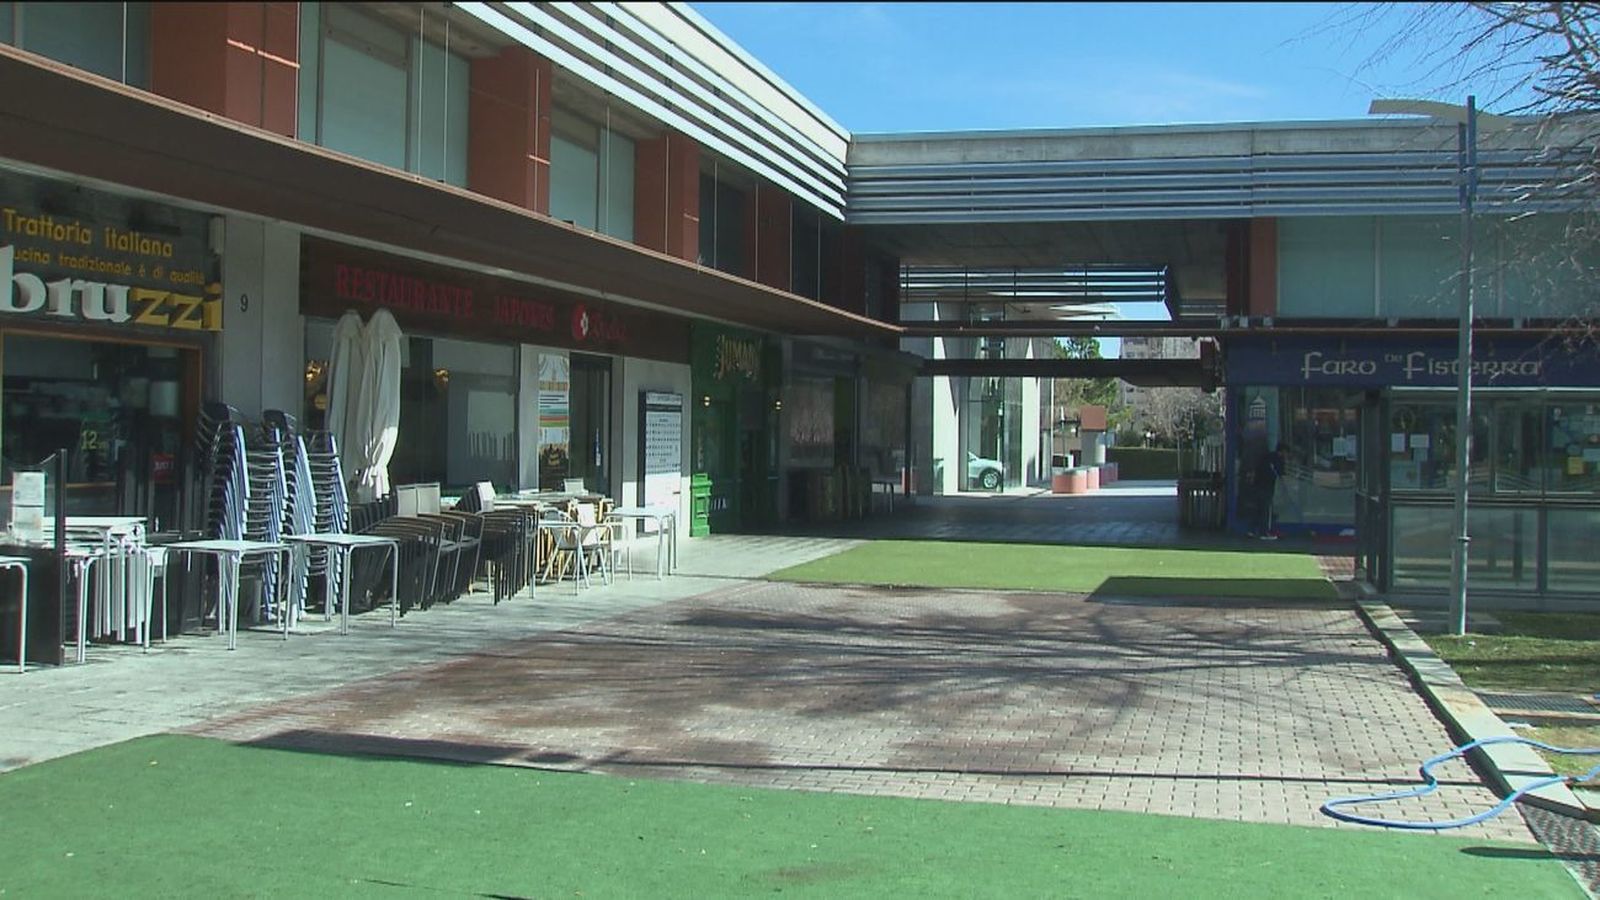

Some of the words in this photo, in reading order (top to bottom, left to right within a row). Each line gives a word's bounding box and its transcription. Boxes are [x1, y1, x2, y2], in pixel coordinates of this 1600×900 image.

[3, 207, 92, 245] Trattoria
[105, 226, 173, 257] italiana
[13, 245, 50, 265] ucina
[59, 252, 132, 276] tradizionale
[0, 244, 223, 332] bruzzi
[240, 294, 249, 312] 9
[335, 264, 473, 320] RESTAURANTE
